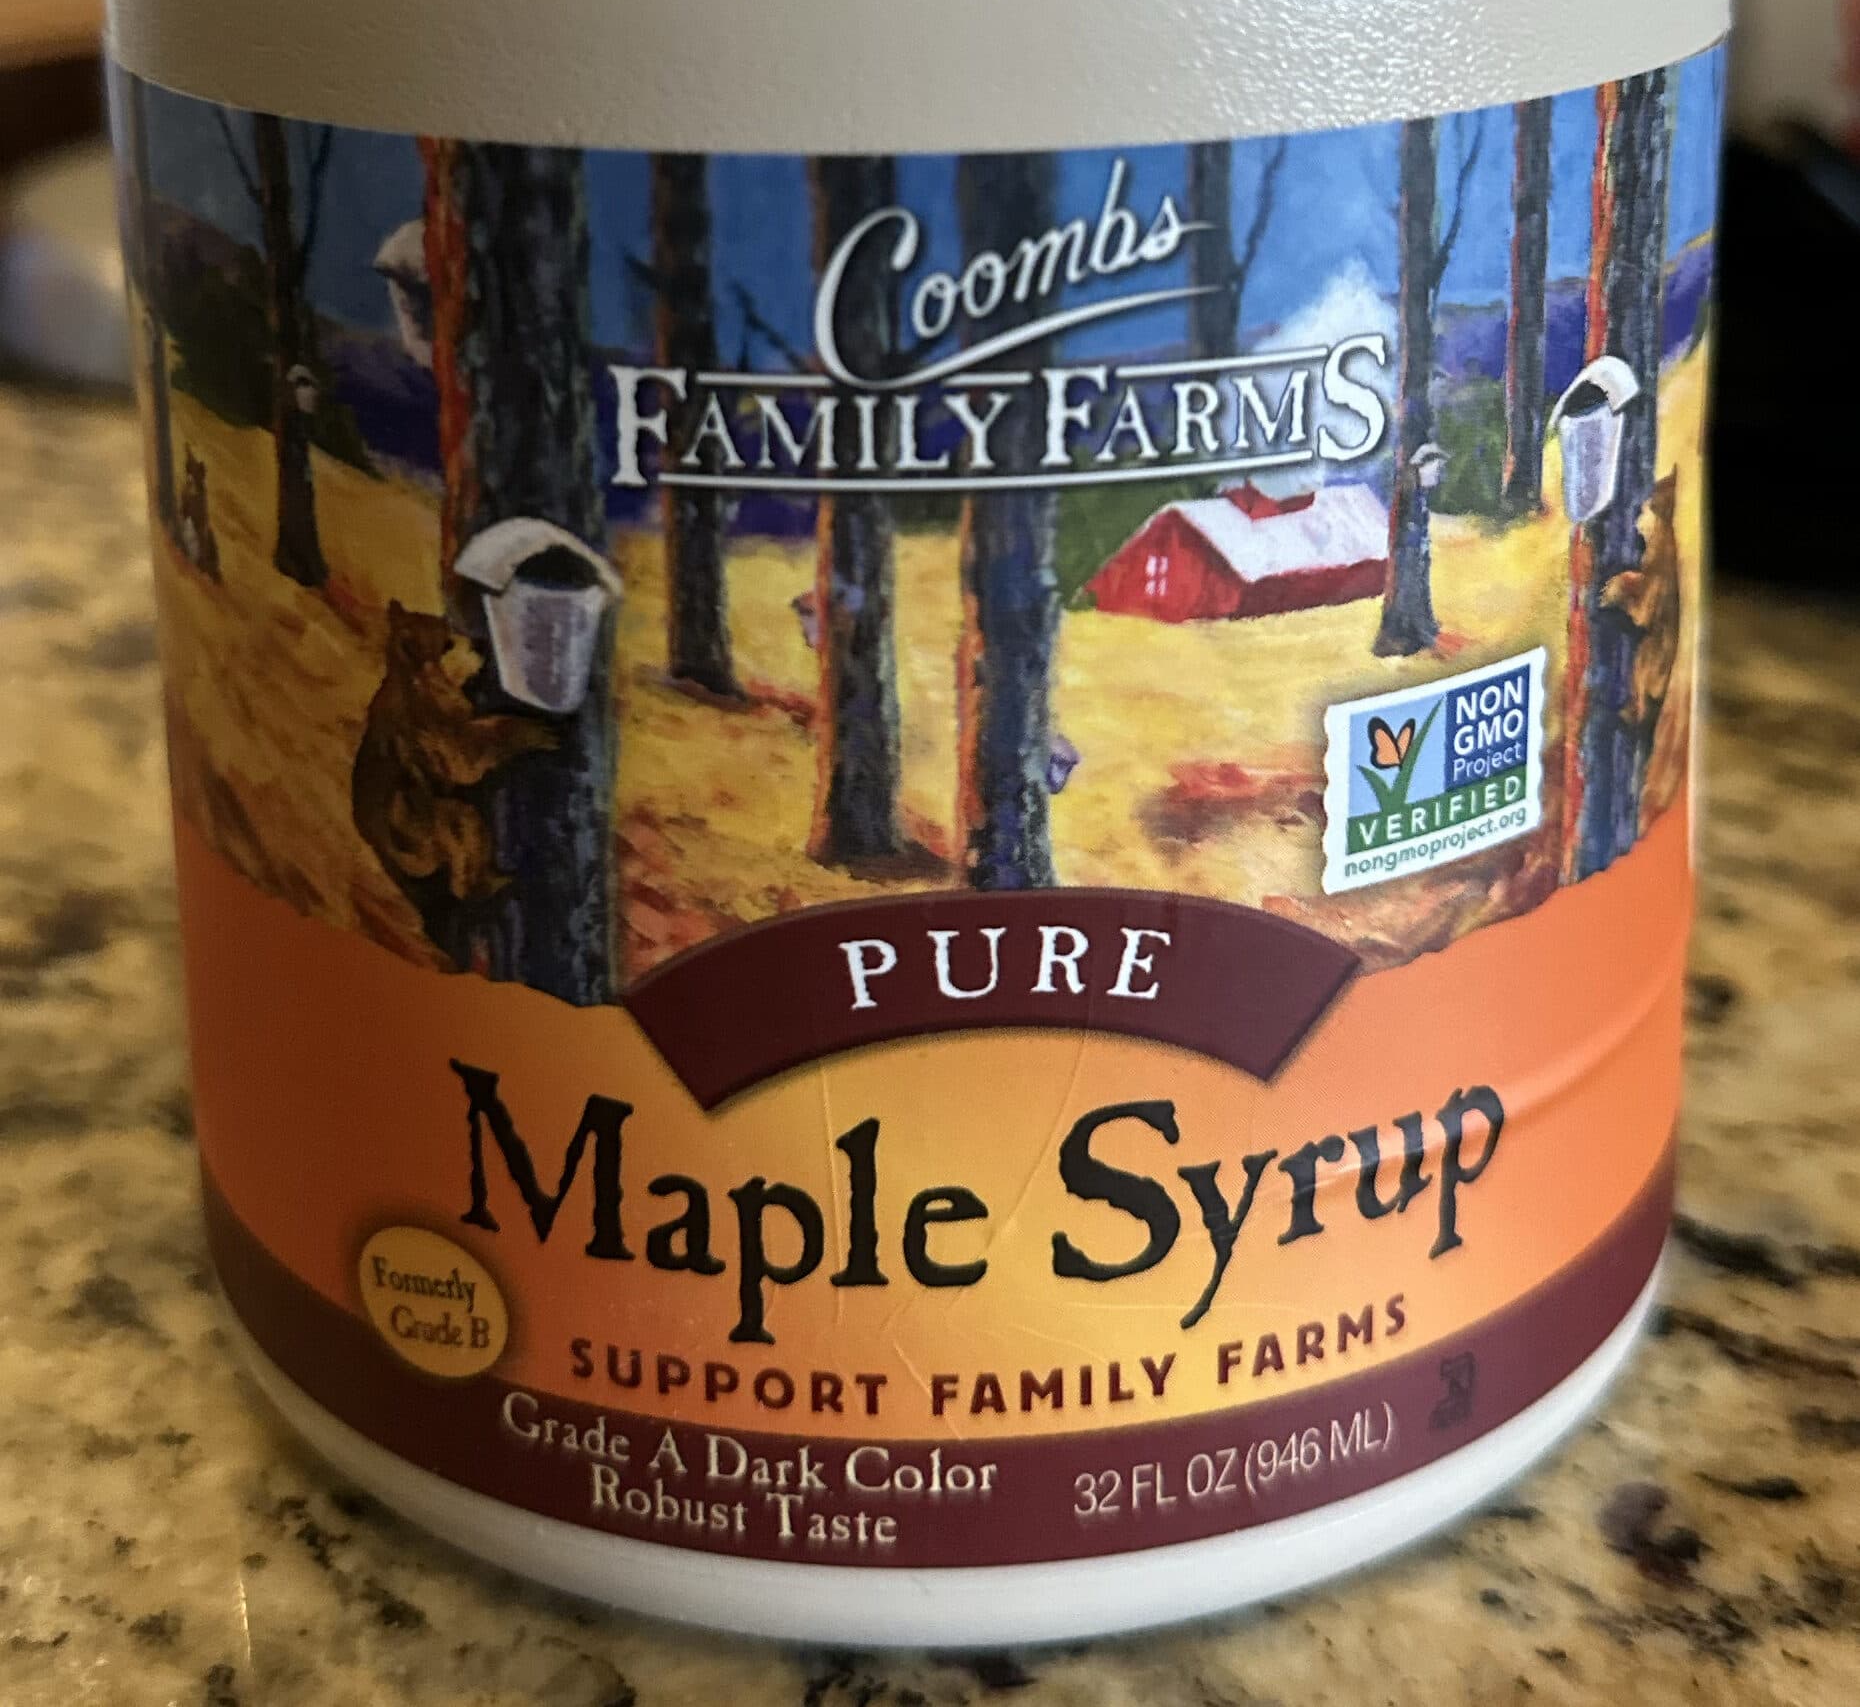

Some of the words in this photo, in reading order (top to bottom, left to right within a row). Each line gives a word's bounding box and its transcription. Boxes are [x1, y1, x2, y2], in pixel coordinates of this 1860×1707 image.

[813, 157, 1217, 390] Coombs
[607, 364, 1012, 490] FAMILY
[1040, 334, 1388, 467] FARMS
[1453, 708, 1524, 756] GMO
[1455, 675, 1524, 725] NON
[1452, 743, 1522, 782] Project
[1344, 806, 1527, 877] nongmoproject.org
[1358, 775, 1521, 847] VERIFIED
[838, 924, 1172, 1010] PURE
[450, 1058, 990, 1345] Maple
[1052, 1084, 1506, 1329] Syrup
[370, 1254, 478, 1312] Formerly
[390, 1302, 470, 1348] Grade
[470, 1316, 492, 1350] B
[571, 1336, 888, 1416] SUPPORT
[931, 1353, 1176, 1417] FAMILY
[1217, 1293, 1408, 1385] FARMS
[502, 1392, 632, 1464] Grade
[648, 1426, 688, 1475] A
[706, 1434, 826, 1492] Dark
[846, 1446, 998, 1494] Color
[1073, 1469, 1123, 1517] 32
[1131, 1460, 1177, 1510] FL
[1328, 1401, 1397, 1460] ML)
[590, 1464, 750, 1535] Robust
[766, 1490, 898, 1546] Taste
